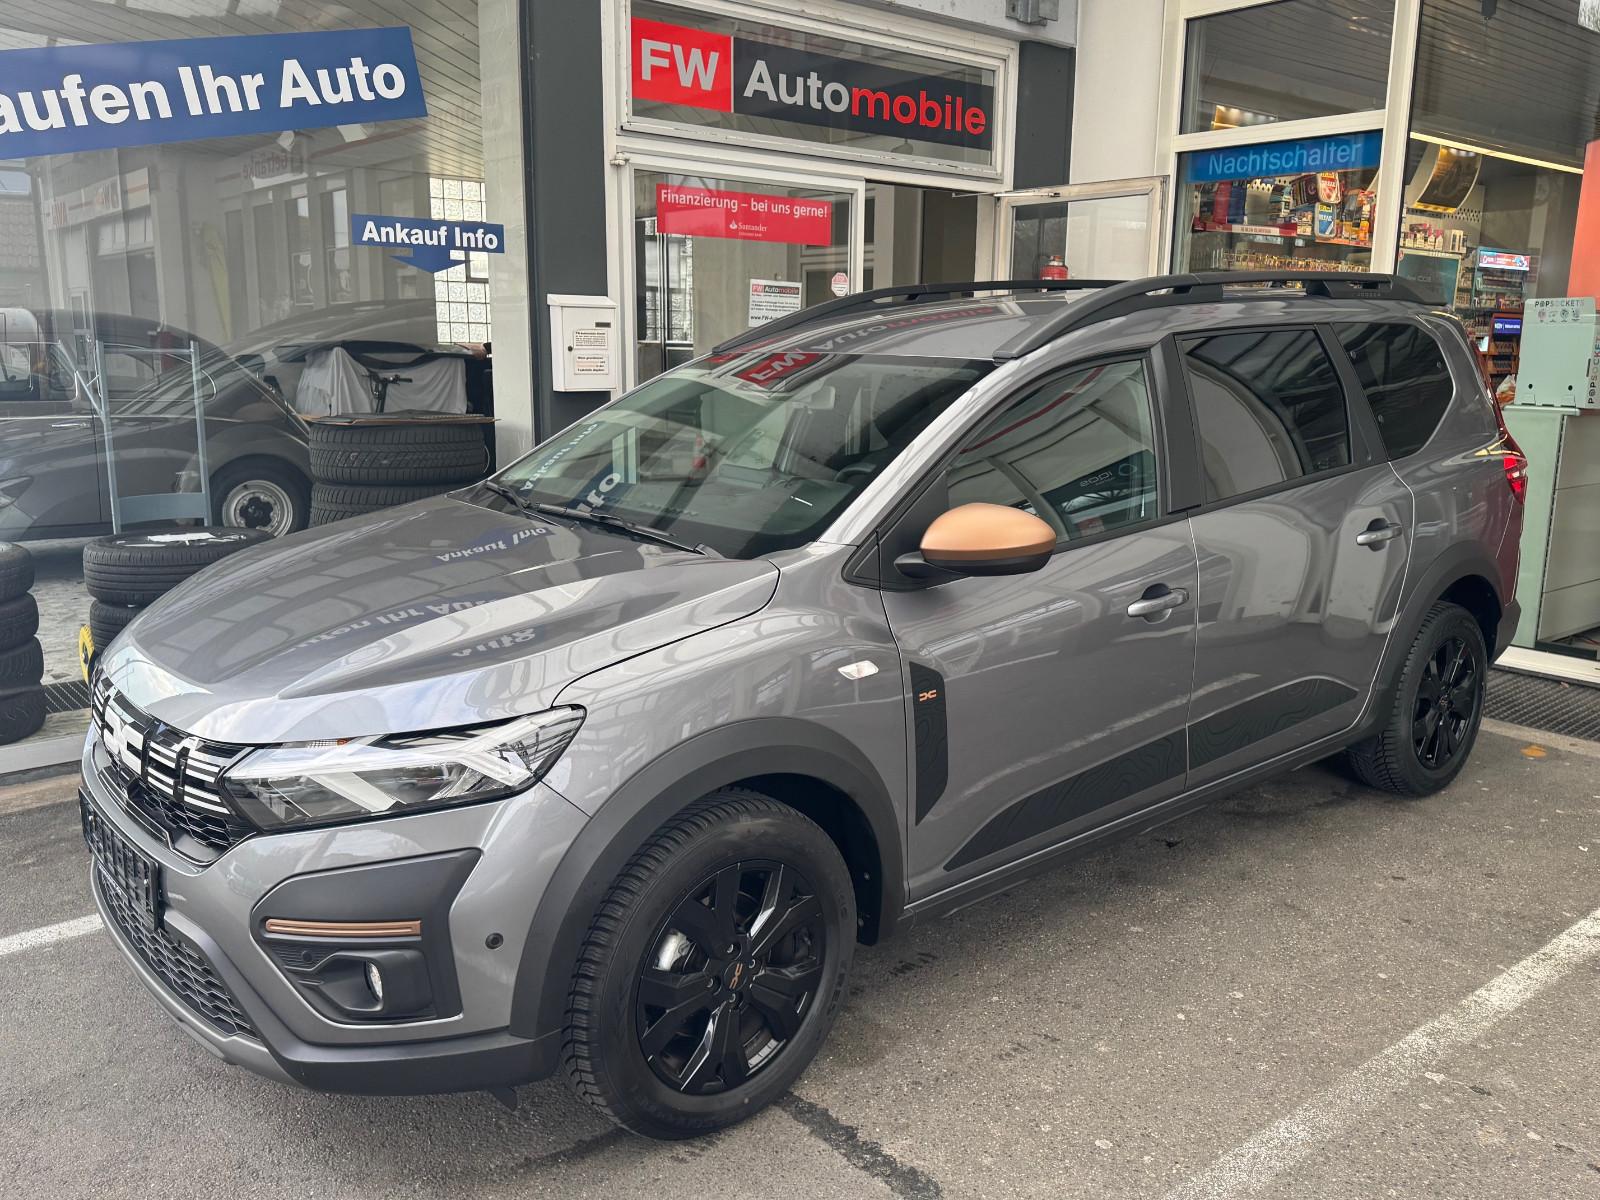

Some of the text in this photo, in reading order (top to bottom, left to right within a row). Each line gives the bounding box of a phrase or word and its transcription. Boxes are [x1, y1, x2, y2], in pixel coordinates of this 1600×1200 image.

[0, 56, 407, 135] aufen Ihr Auto
[640, 38, 987, 136] FW Automobile
[1208, 141, 1363, 176] Nachtschalter
[661, 189, 738, 212] Finanzierung
[751, 198, 768, 212] bei
[771, 202, 790, 214] uns
[793, 205, 828, 219] gerne!
[362, 220, 499, 250] Ankauf Info
[738, 222, 767, 232] Santander
[752, 284, 763, 292] FW
